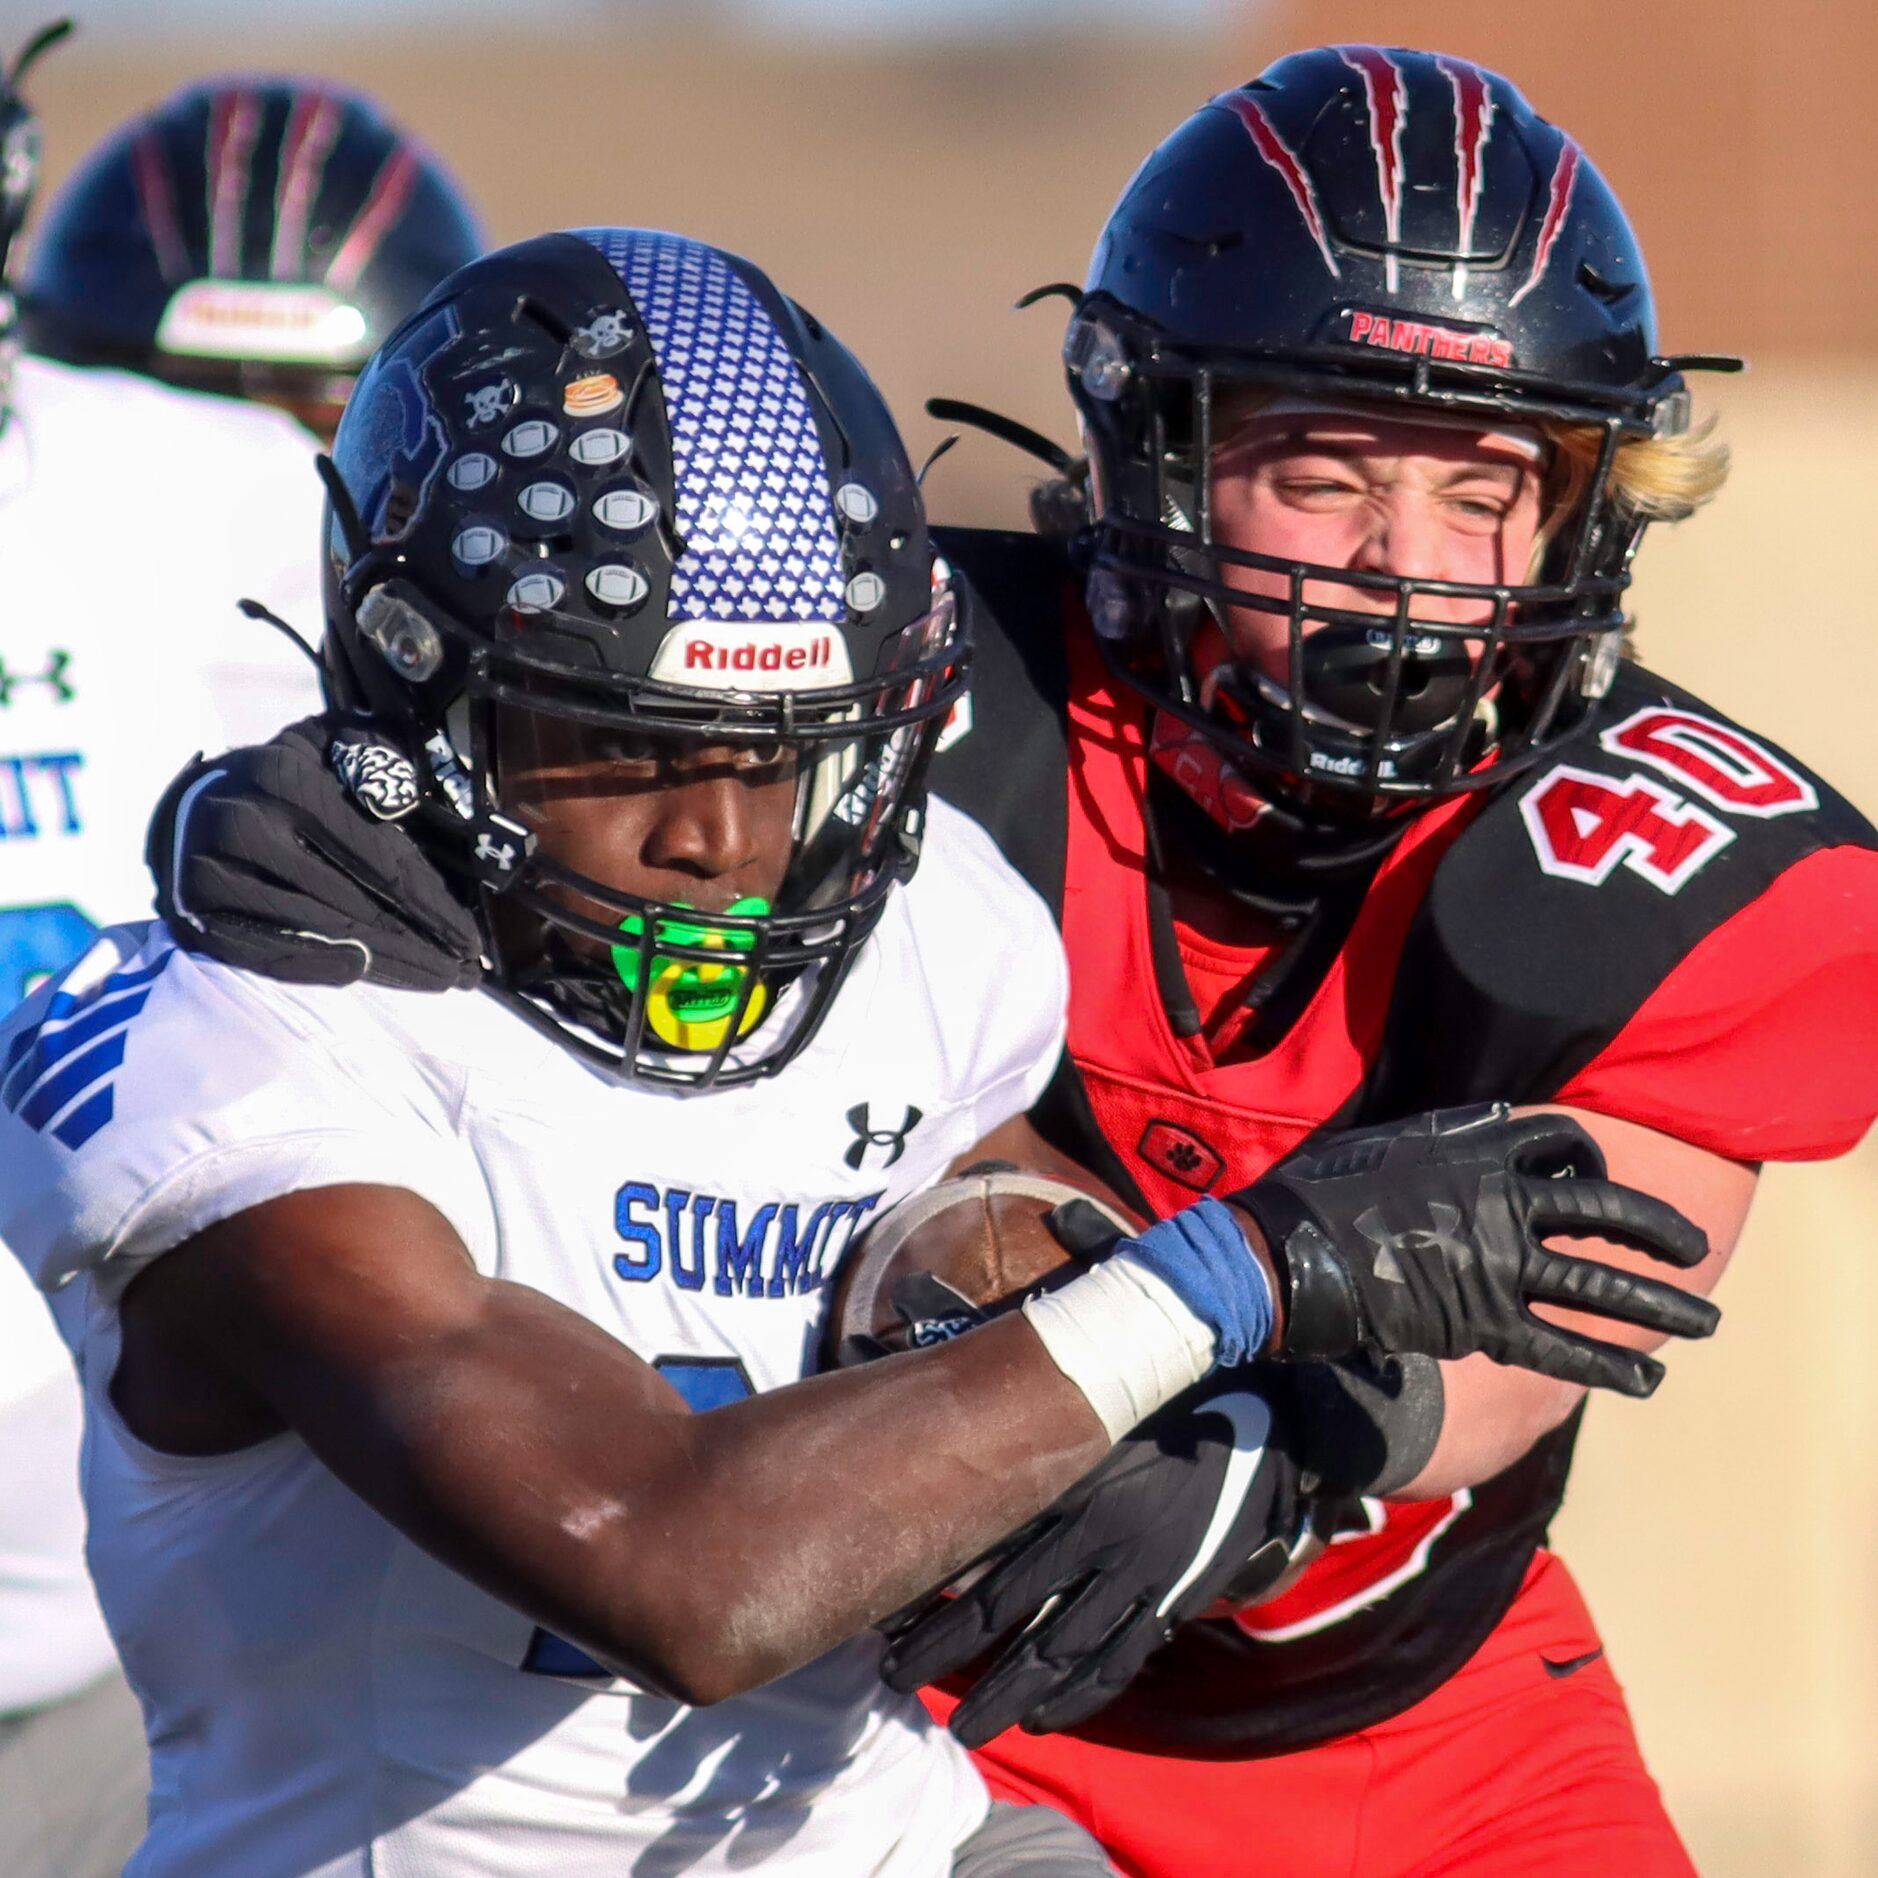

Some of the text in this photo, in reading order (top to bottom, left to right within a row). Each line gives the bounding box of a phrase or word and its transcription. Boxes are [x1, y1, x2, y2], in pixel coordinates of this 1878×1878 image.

[1350, 311, 1514, 368] PANTHERS
[685, 637, 831, 670] Riddell
[1519, 706, 1821, 895] 40
[613, 1180, 887, 1298] SUMMIT
